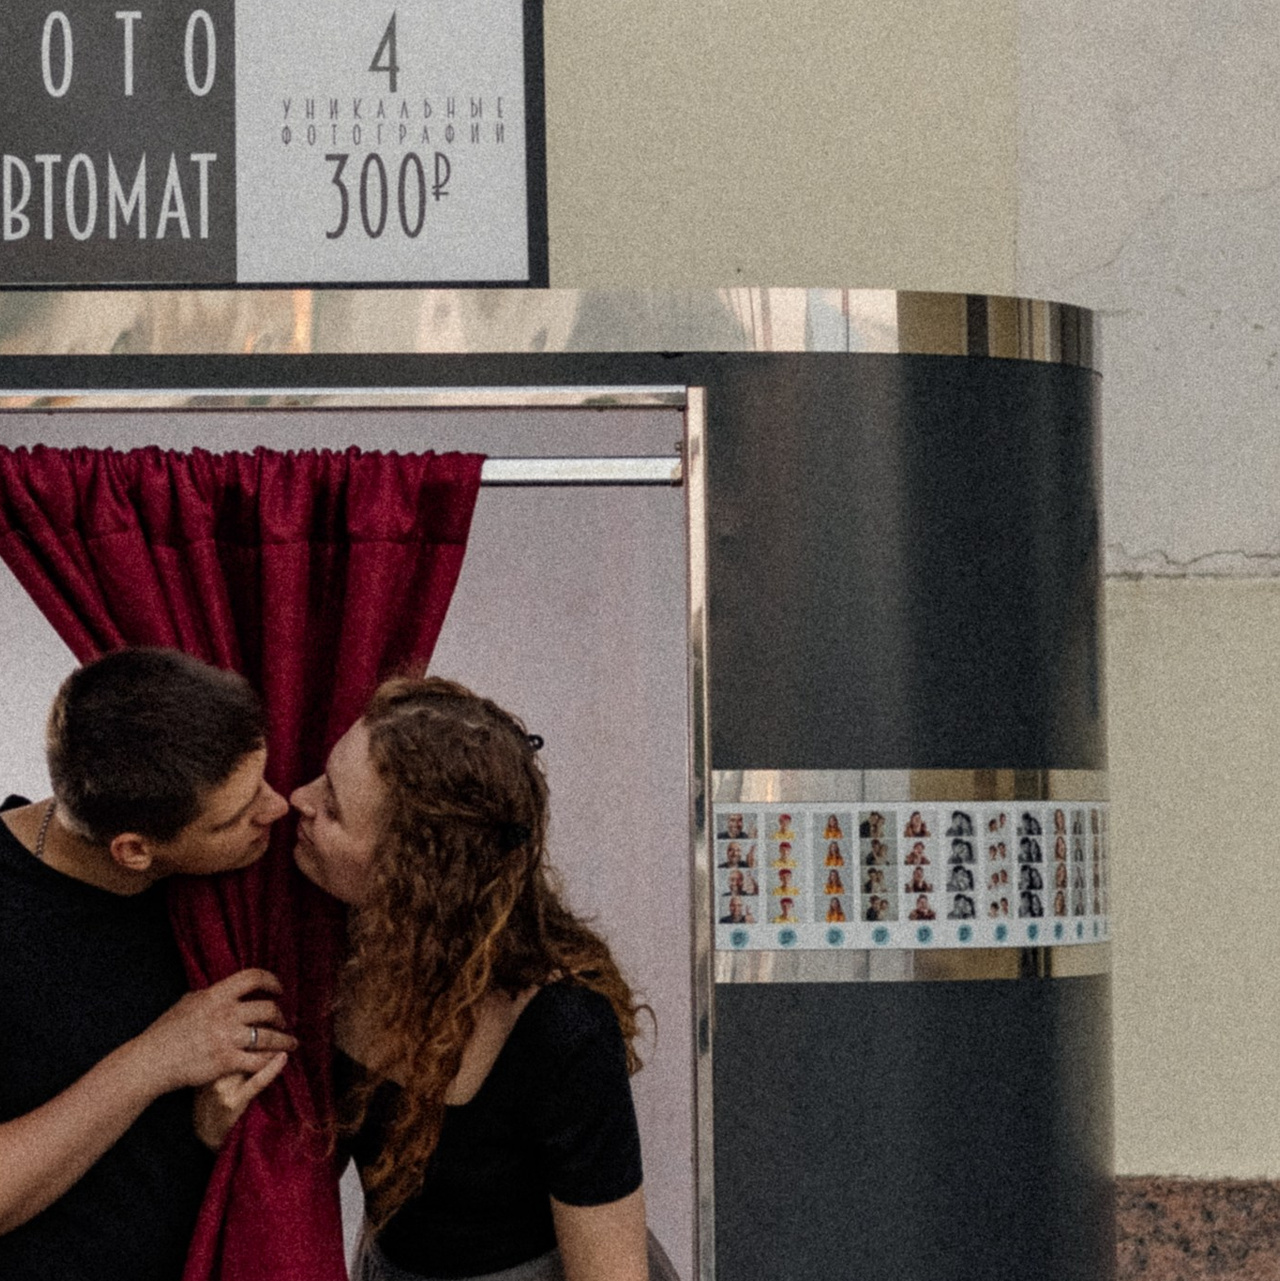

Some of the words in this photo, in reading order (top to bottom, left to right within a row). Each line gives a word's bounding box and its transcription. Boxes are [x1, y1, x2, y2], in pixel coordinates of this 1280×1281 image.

[368, 9, 400, 93] 4
[282, 96, 504, 120] УНИКАЛЬНЫЕ
[281, 123, 505, 146] ФОТОГРАФИИ
